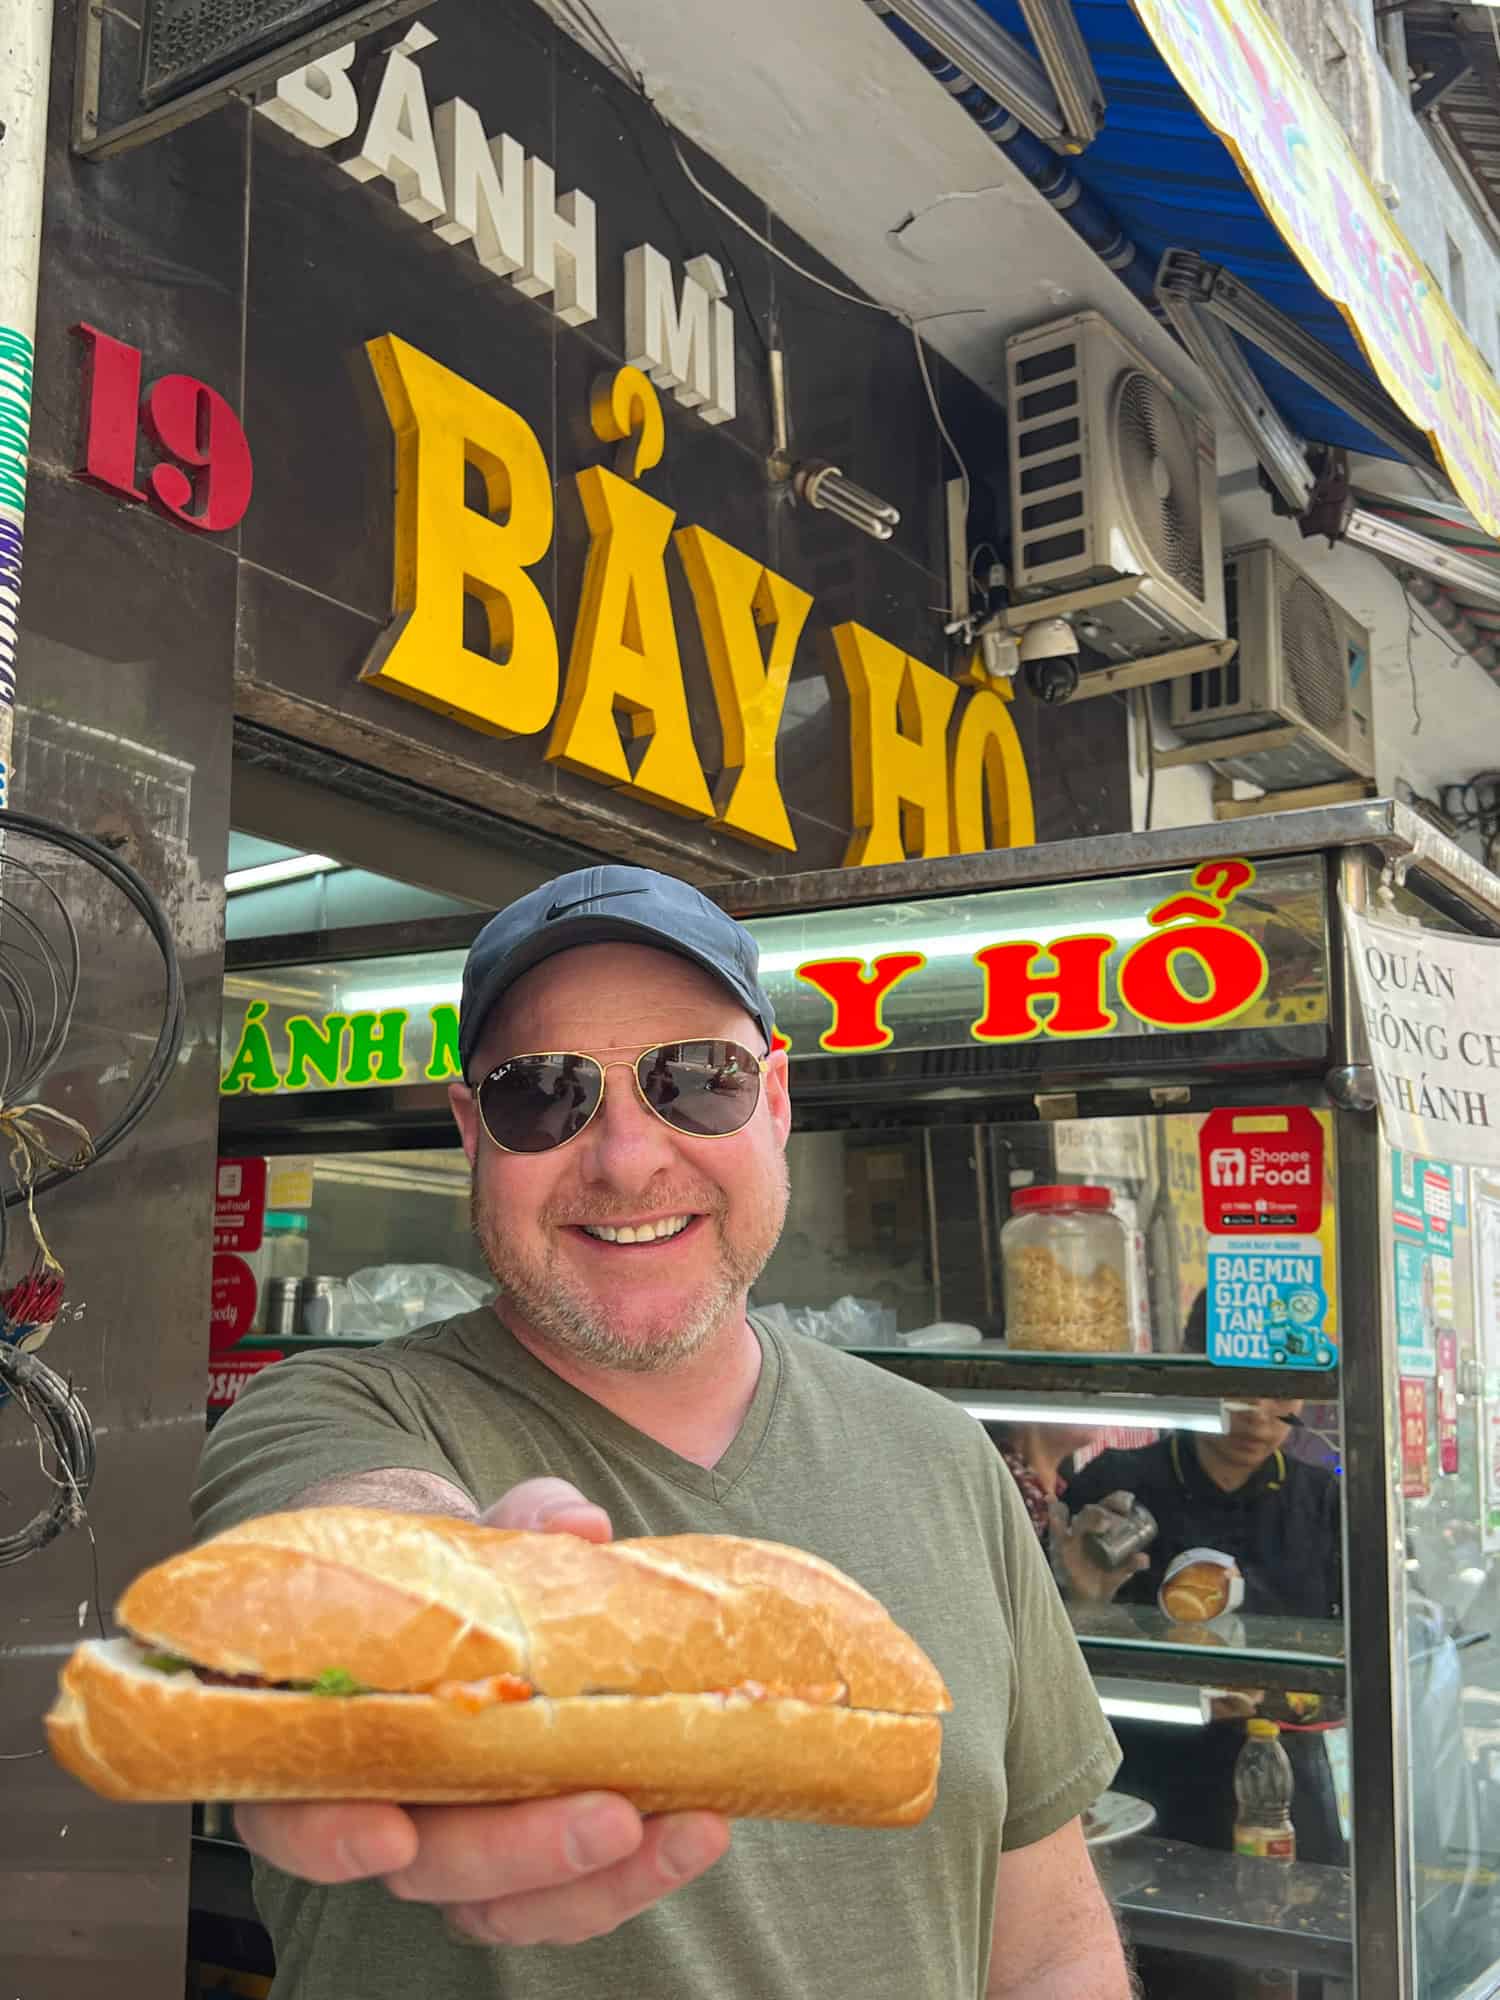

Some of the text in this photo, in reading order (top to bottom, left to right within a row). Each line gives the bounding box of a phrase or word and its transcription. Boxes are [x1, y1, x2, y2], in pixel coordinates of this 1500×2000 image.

[254, 21, 598, 327] BÁNH
[68, 320, 254, 532] 19
[359, 332, 815, 852] BẢY
[971, 858, 1269, 1030] HỔ
[1365, 946, 1456, 1000] QUÁN
[219, 999, 463, 1095] ÁNH M
[1364, 1003, 1500, 1068] HÔNG CH
[1377, 1066, 1494, 1127] NHÁNH
[1250, 1147, 1311, 1167] Shopee
[1250, 1164, 1311, 1186] Food
[1215, 1257, 1314, 1283] BAEMIN
